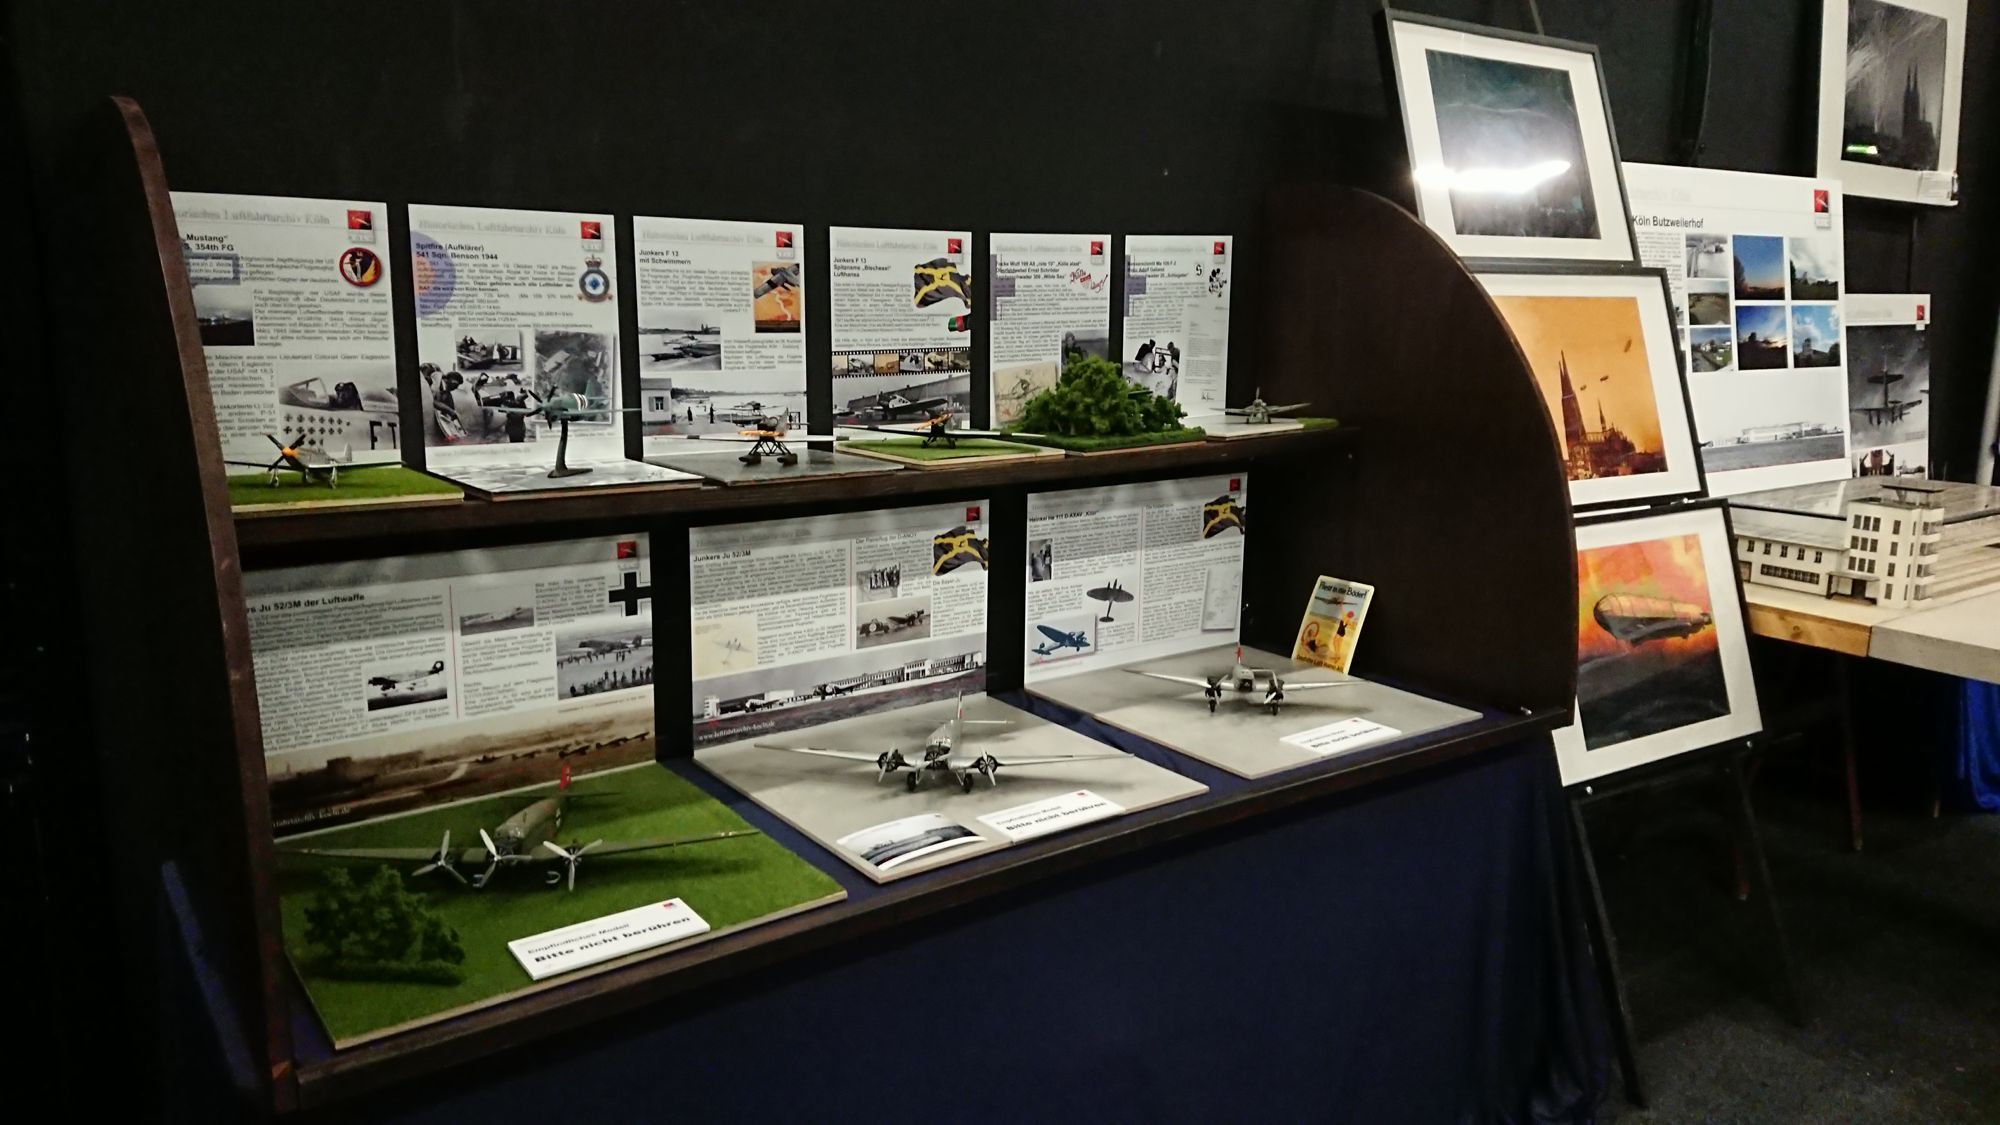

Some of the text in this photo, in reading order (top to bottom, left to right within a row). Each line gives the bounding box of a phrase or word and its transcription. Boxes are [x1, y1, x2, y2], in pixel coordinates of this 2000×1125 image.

[1631, 215, 1705, 229] Köln Butzweilerhof
[415, 242, 485, 252] Spitfire (Aufklärer)
[639, 249, 665, 257] Junkers
[450, 252, 480, 260] Benson
[481, 253, 499, 261] 1944
[693, 554, 721, 562] Junkers
[731, 550, 752, 558] 52/3M
[259, 605, 271, 613] Ju
[273, 600, 302, 611] 52/3M
[304, 599, 320, 607] der
[321, 593, 365, 605] Luftwaffe
[598, 922, 630, 936] Modell
[534, 915, 691, 963] Bitte nicht berühren
